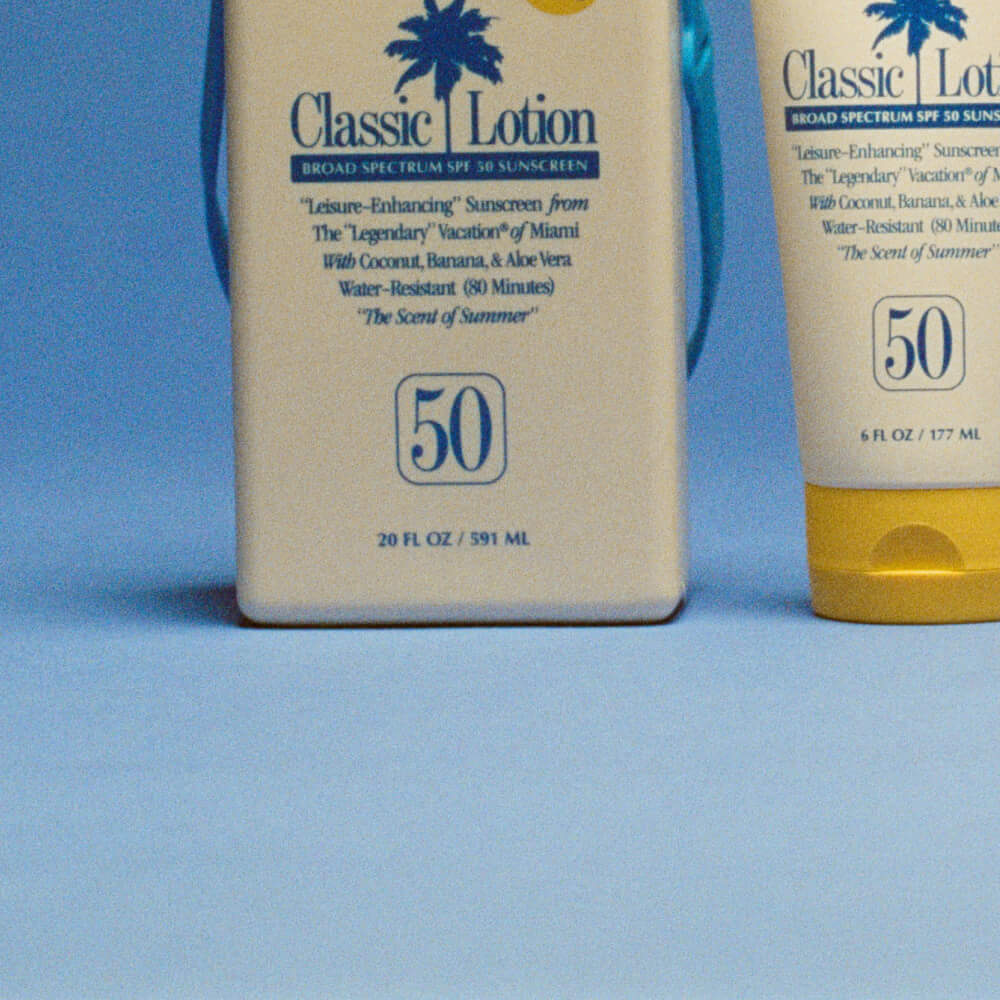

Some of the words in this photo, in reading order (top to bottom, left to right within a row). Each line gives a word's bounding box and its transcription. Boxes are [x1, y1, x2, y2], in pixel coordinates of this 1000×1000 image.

[782, 49, 905, 101] Classic
[290, 91, 433, 149] Classic
[467, 90, 598, 147] Lotion
[792, 112, 838, 125] BROAD
[841, 110, 913, 125] SPECTRUM
[917, 110, 940, 123] SPF
[944, 109, 960, 123] 50
[302, 161, 357, 176] BROAD
[361, 159, 443, 175] SPECTRUM
[447, 159, 471, 174] SPF
[477, 159, 495, 173] 50
[497, 158, 589, 173] SUNSCREEN
[800, 169, 824, 185] The
[974, 167, 990, 185] of
[465, 196, 543, 214] Sunscreen
[547, 193, 589, 216] from
[809, 195, 836, 210] With
[838, 194, 896, 211] Coconut,
[899, 193, 954, 210] Banana,
[956, 193, 967, 209] &
[969, 193, 999, 208] Aloe
[312, 225, 342, 242] The
[510, 221, 529, 243] of
[530, 221, 580, 239] Miami
[821, 218, 924, 235] Water-Resistant
[930, 217, 952, 235] (80
[323, 253, 356, 270] With
[359, 252, 424, 271] Coconut,
[427, 251, 489, 270] Banana,
[491, 251, 503, 268] &
[505, 251, 538, 268] Aloe
[538, 251, 572, 268] Vera
[870, 244, 906, 260] Scent
[910, 243, 925, 263] of
[339, 279, 456, 297] Water-Resistant
[463, 278, 488, 298] (80
[491, 278, 555, 297] Minutes)
[395, 307, 438, 325] Scent
[441, 307, 456, 329] of
[885, 306, 953, 380] 50
[410, 385, 493, 473] 50
[860, 430, 869, 441] 6
[873, 429, 887, 441] FL
[892, 428, 914, 441] OZ
[930, 428, 954, 440] 177
[960, 428, 981, 440] ML
[377, 533, 398, 547] 20
[403, 533, 421, 546] FL
[426, 532, 453, 546] OZ
[470, 532, 498, 546] 591
[505, 532, 531, 546] ML
